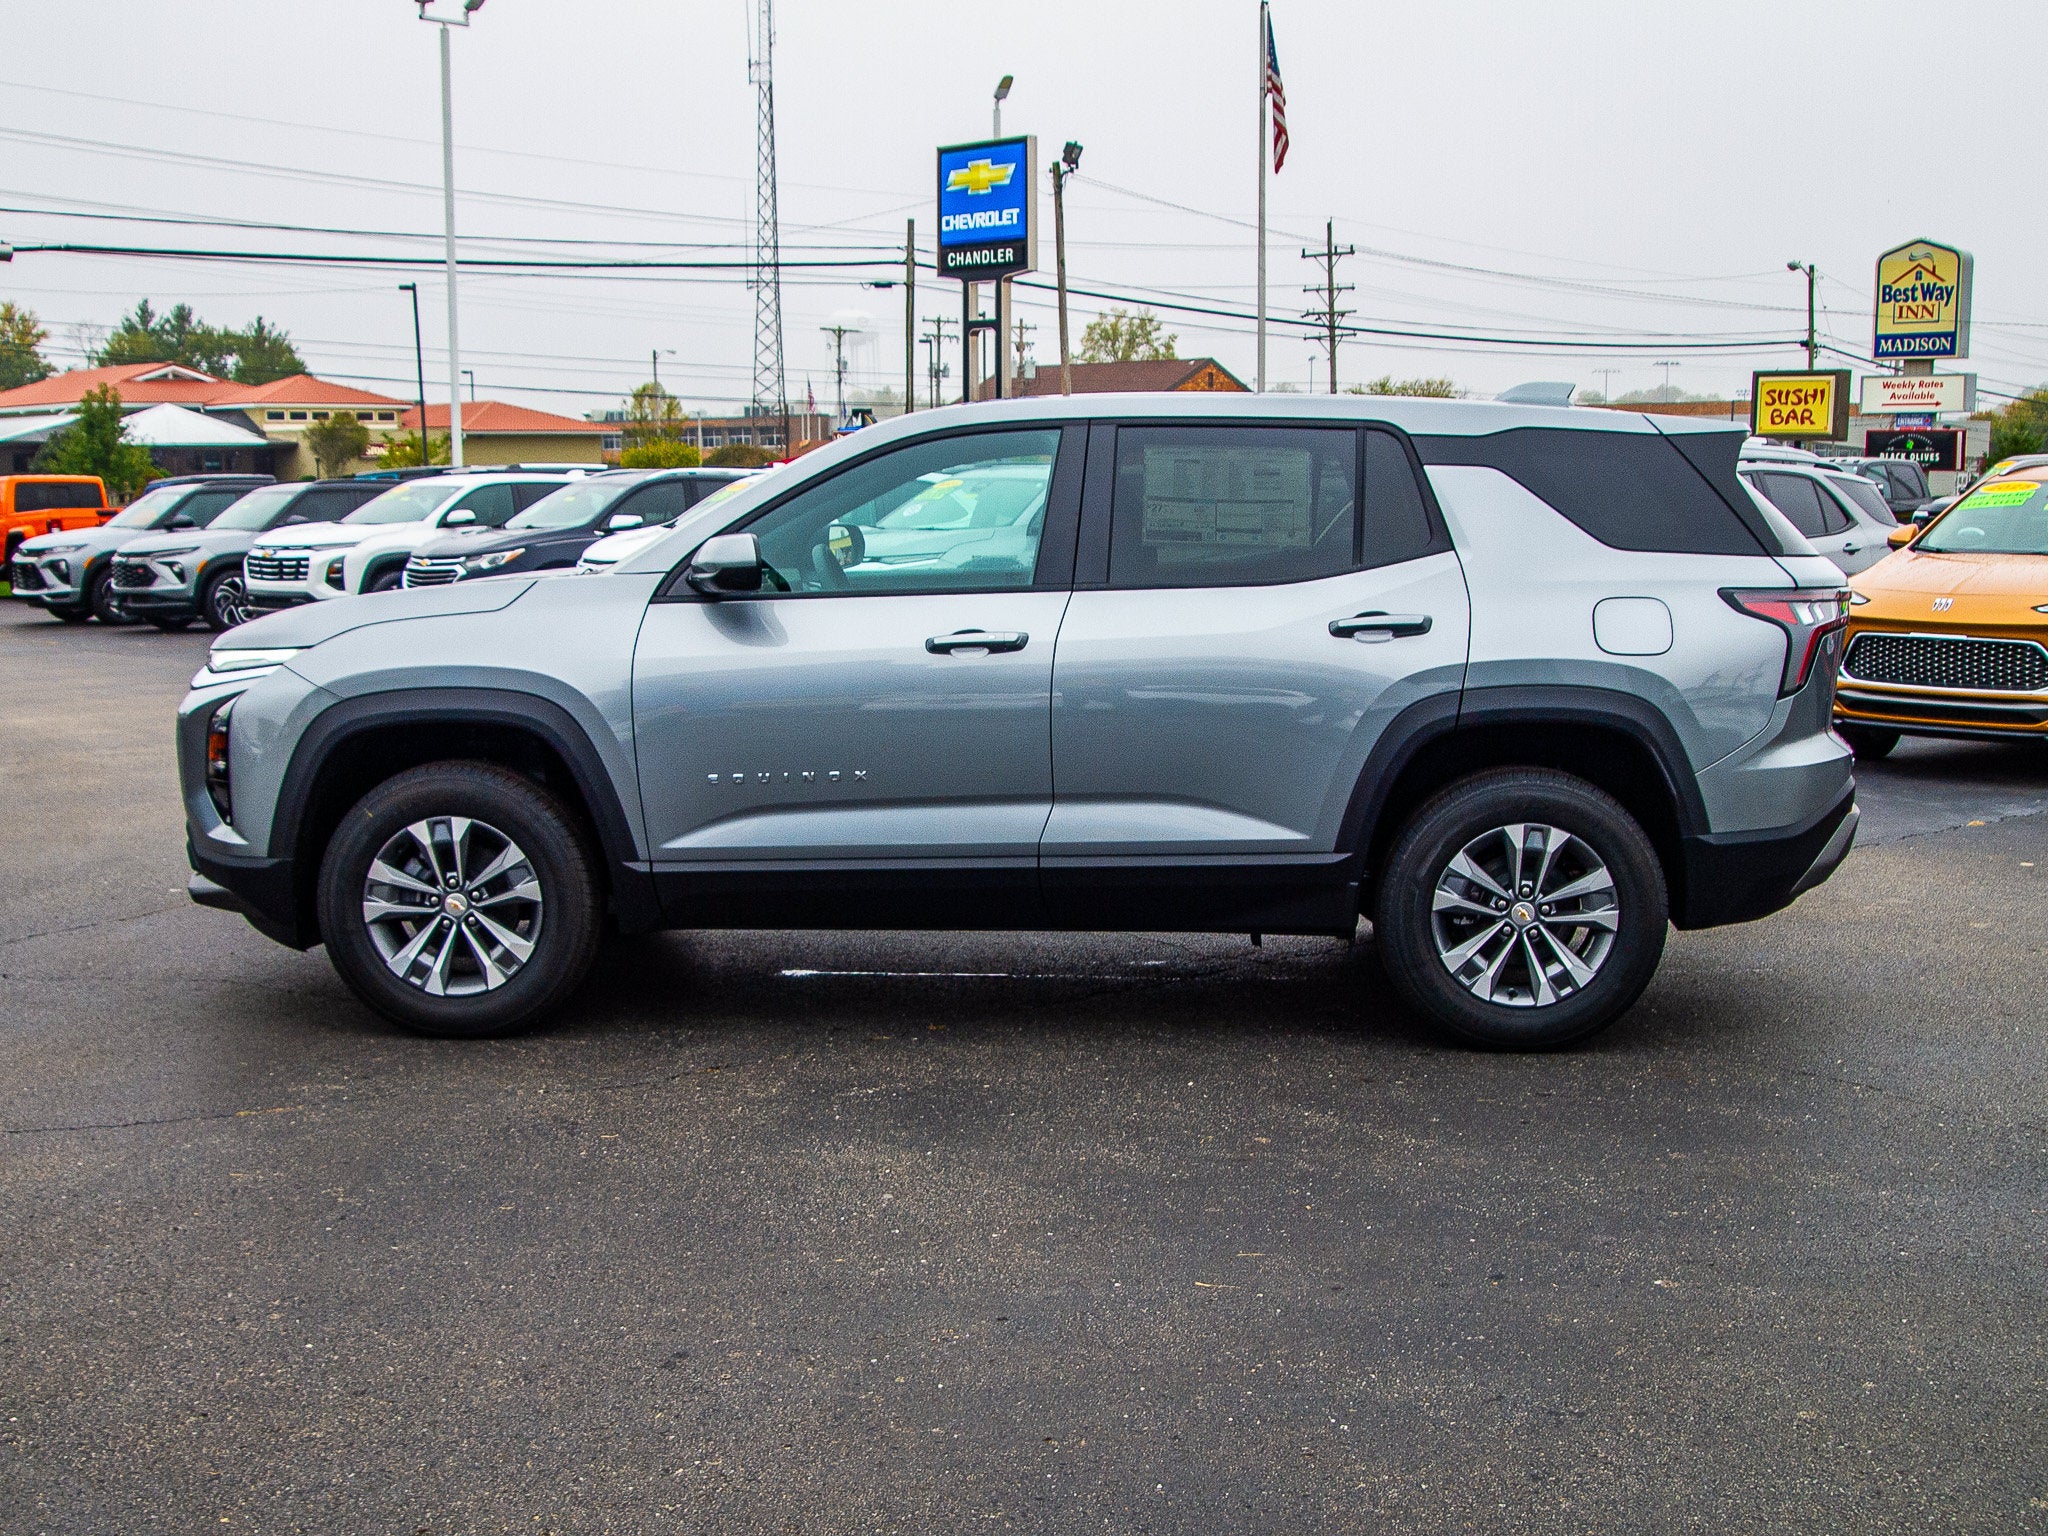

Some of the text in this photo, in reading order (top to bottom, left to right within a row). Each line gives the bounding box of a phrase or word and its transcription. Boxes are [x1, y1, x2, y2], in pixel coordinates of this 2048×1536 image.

[941, 207, 1020, 231] CHEVROLET
[947, 248, 1014, 267] CHANDLER
[1881, 282, 1955, 308] Best Way
[1897, 303, 1936, 319] INN
[1879, 337, 1952, 353] MADISON
[1882, 380, 1944, 391] Weekly Rates
[1764, 388, 1826, 406] SUSHI
[1889, 392, 1935, 400] Available
[1770, 407, 1816, 425] BAR
[1909, 452, 1940, 462] OLIVES
[707, 770, 867, 784] EQUINOX
